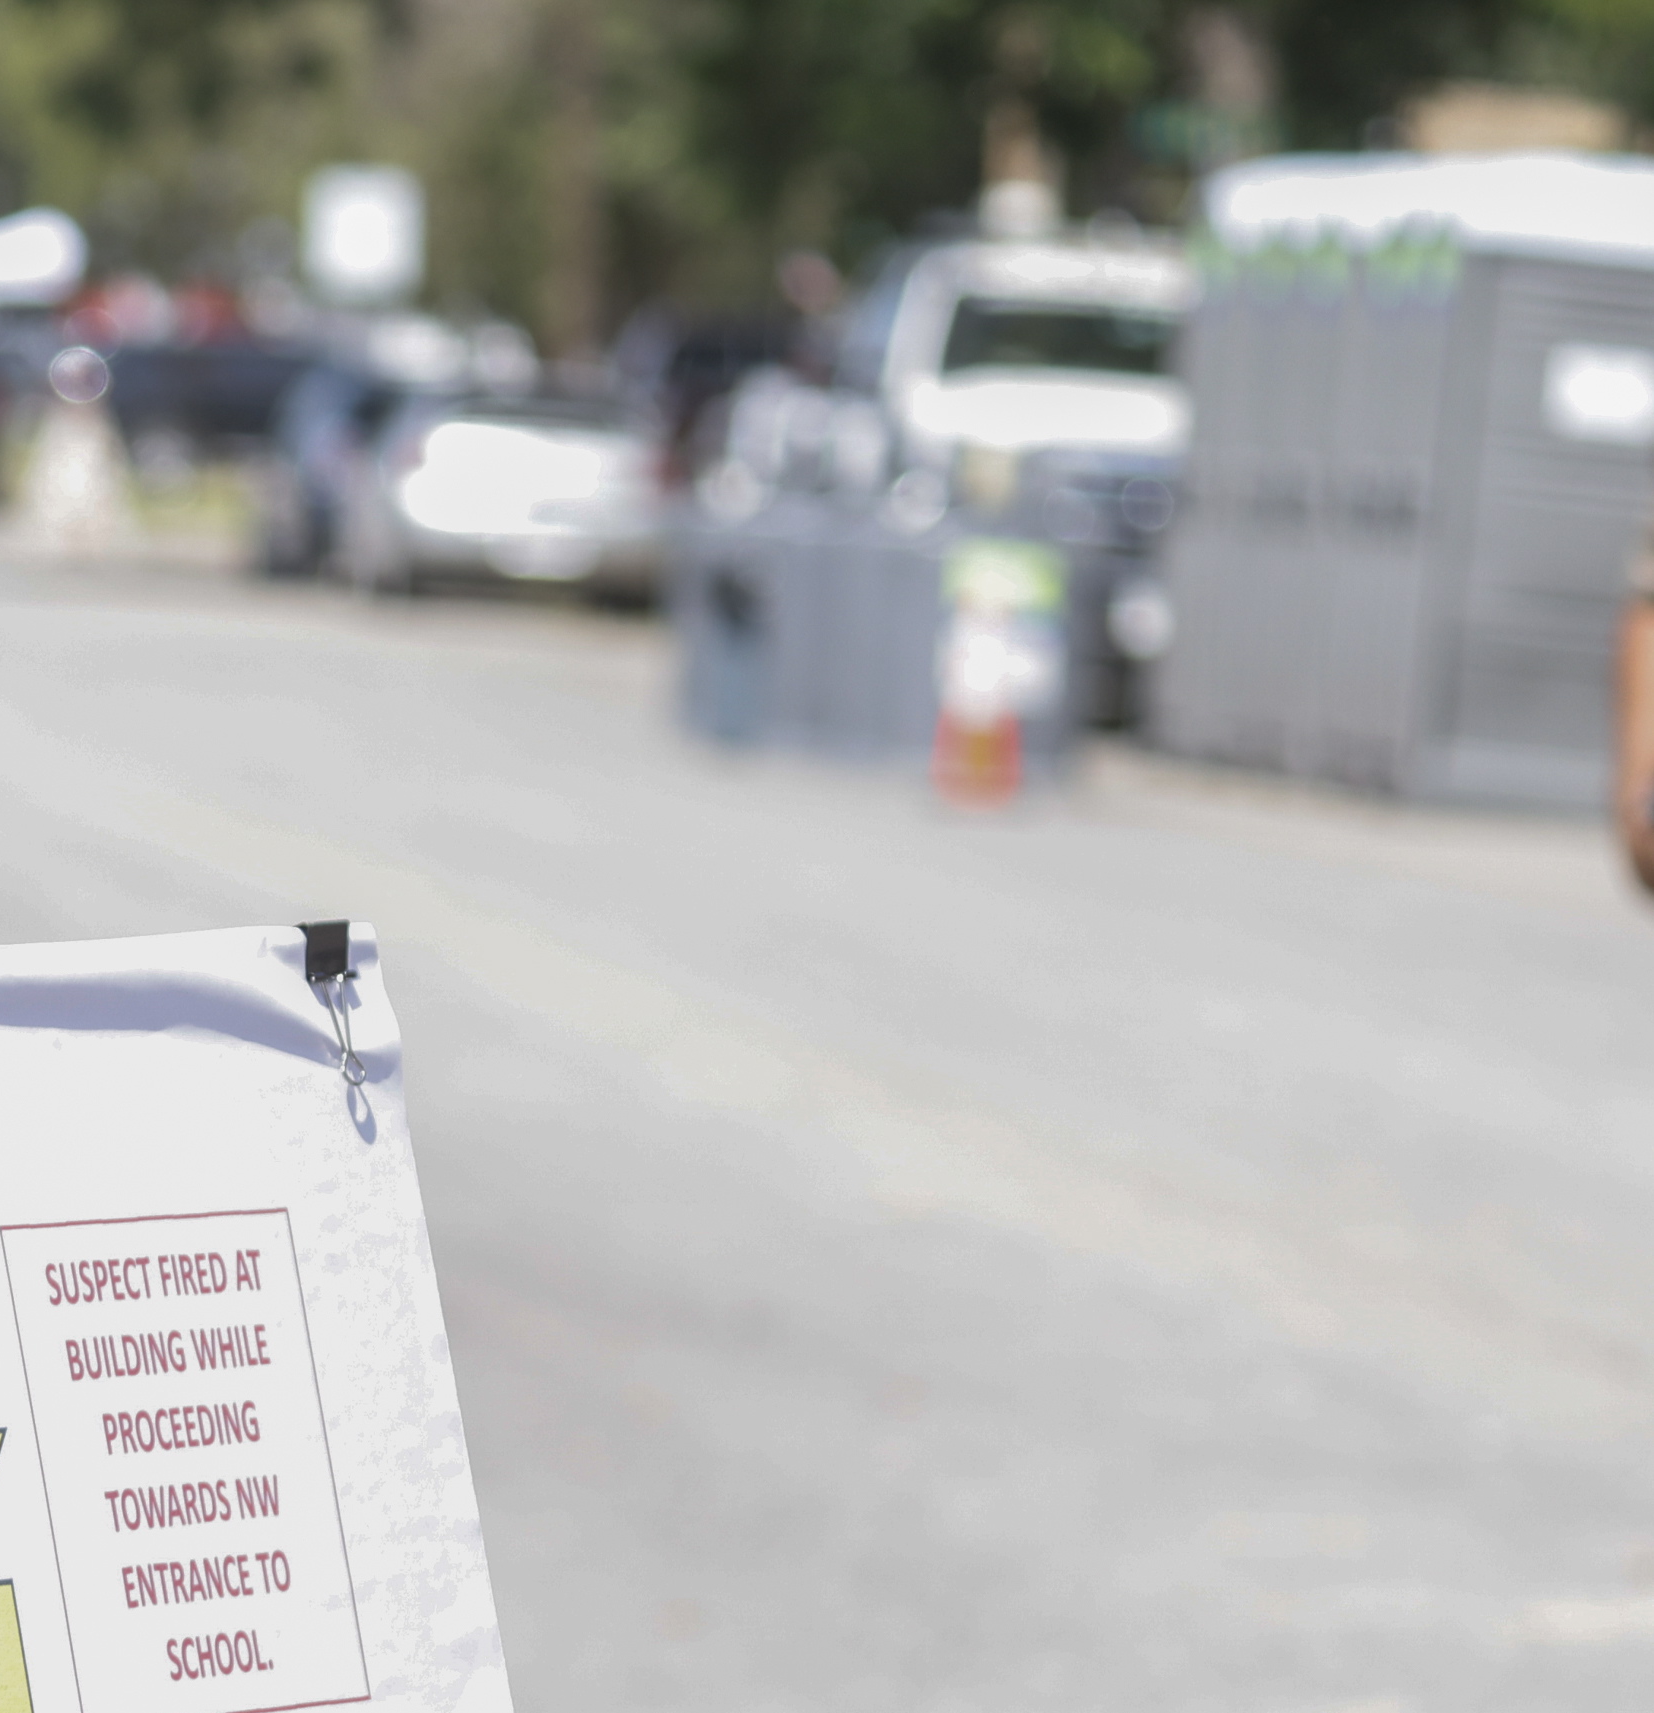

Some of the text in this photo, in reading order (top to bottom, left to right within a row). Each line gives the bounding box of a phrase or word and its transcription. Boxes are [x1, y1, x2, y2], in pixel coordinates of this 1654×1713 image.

[44, 1247, 264, 1307] SUSPECT FIRED AT
[64, 1323, 272, 1383] BUILDING WHILE
[101, 1399, 262, 1457] PROCEEDING
[103, 1473, 281, 1534] TOWARDS NW
[120, 1548, 292, 1610] ENTRANCE TO
[165, 1628, 275, 1683] SCHOOL.
